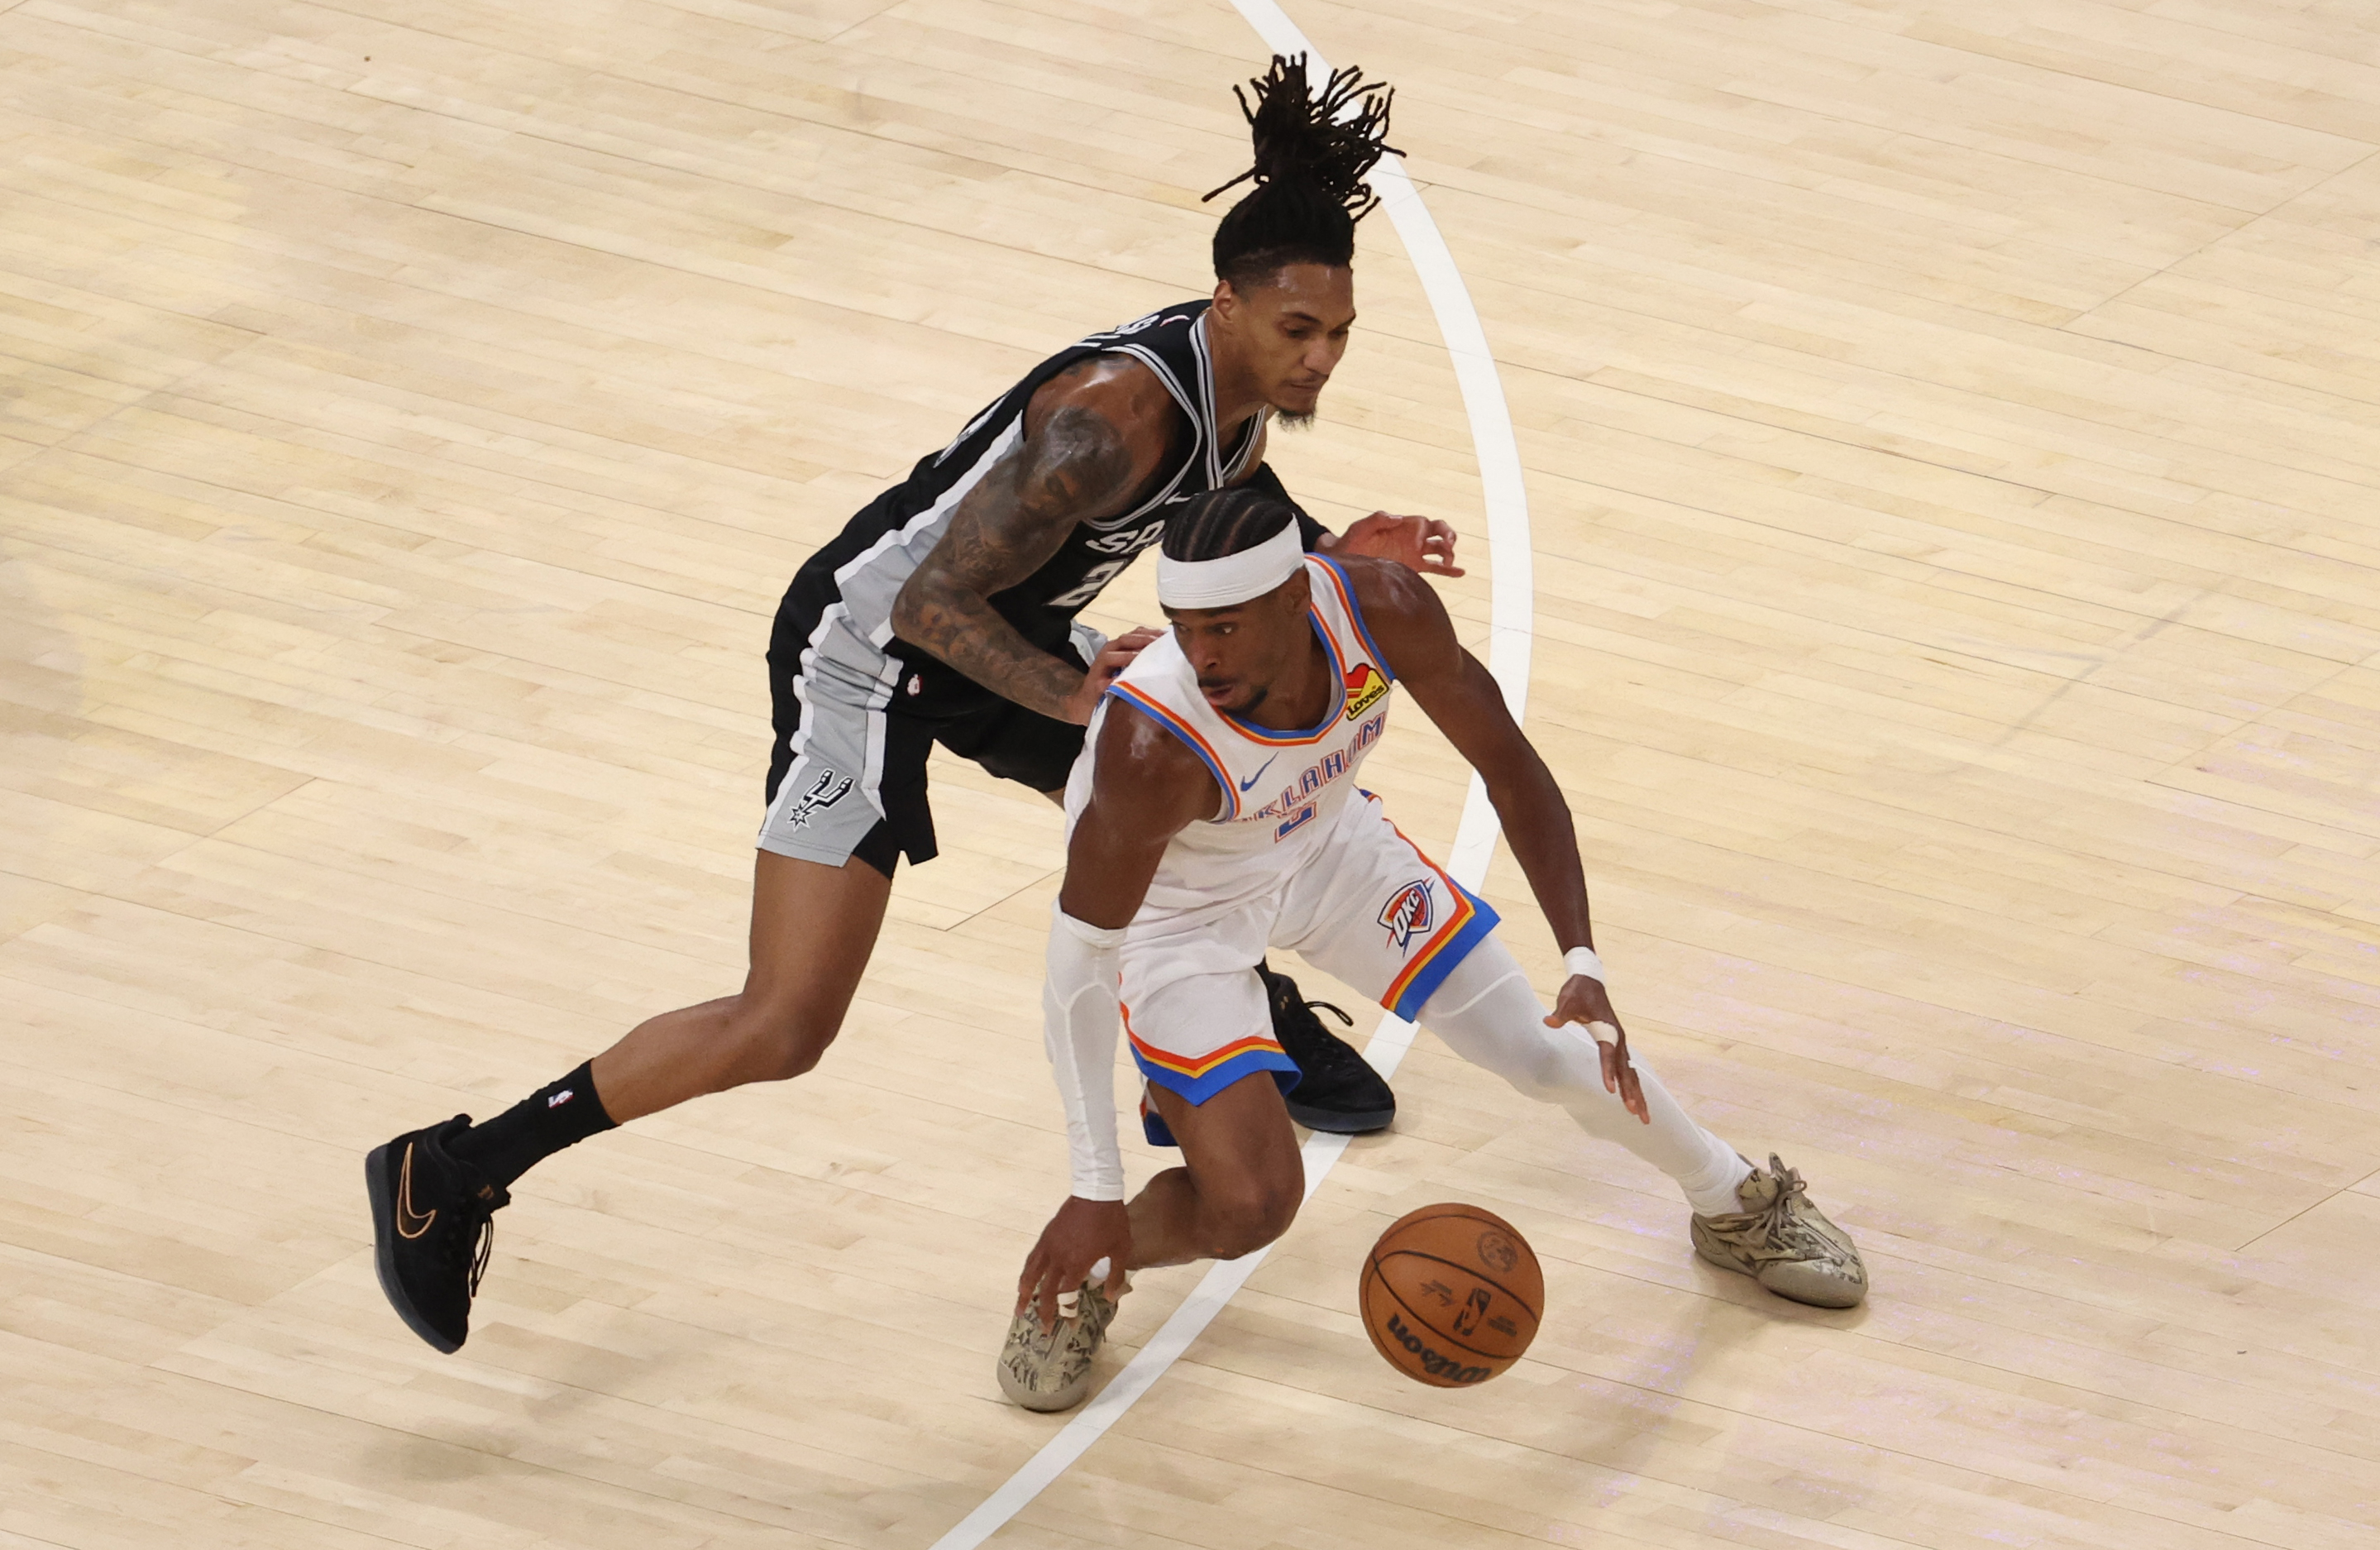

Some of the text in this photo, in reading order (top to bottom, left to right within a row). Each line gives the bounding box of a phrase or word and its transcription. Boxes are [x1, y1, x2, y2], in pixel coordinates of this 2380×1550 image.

[1084, 519, 1166, 555] SP
[1392, 888, 1421, 948] OKC
[1386, 1313, 1493, 1382] Wilson
